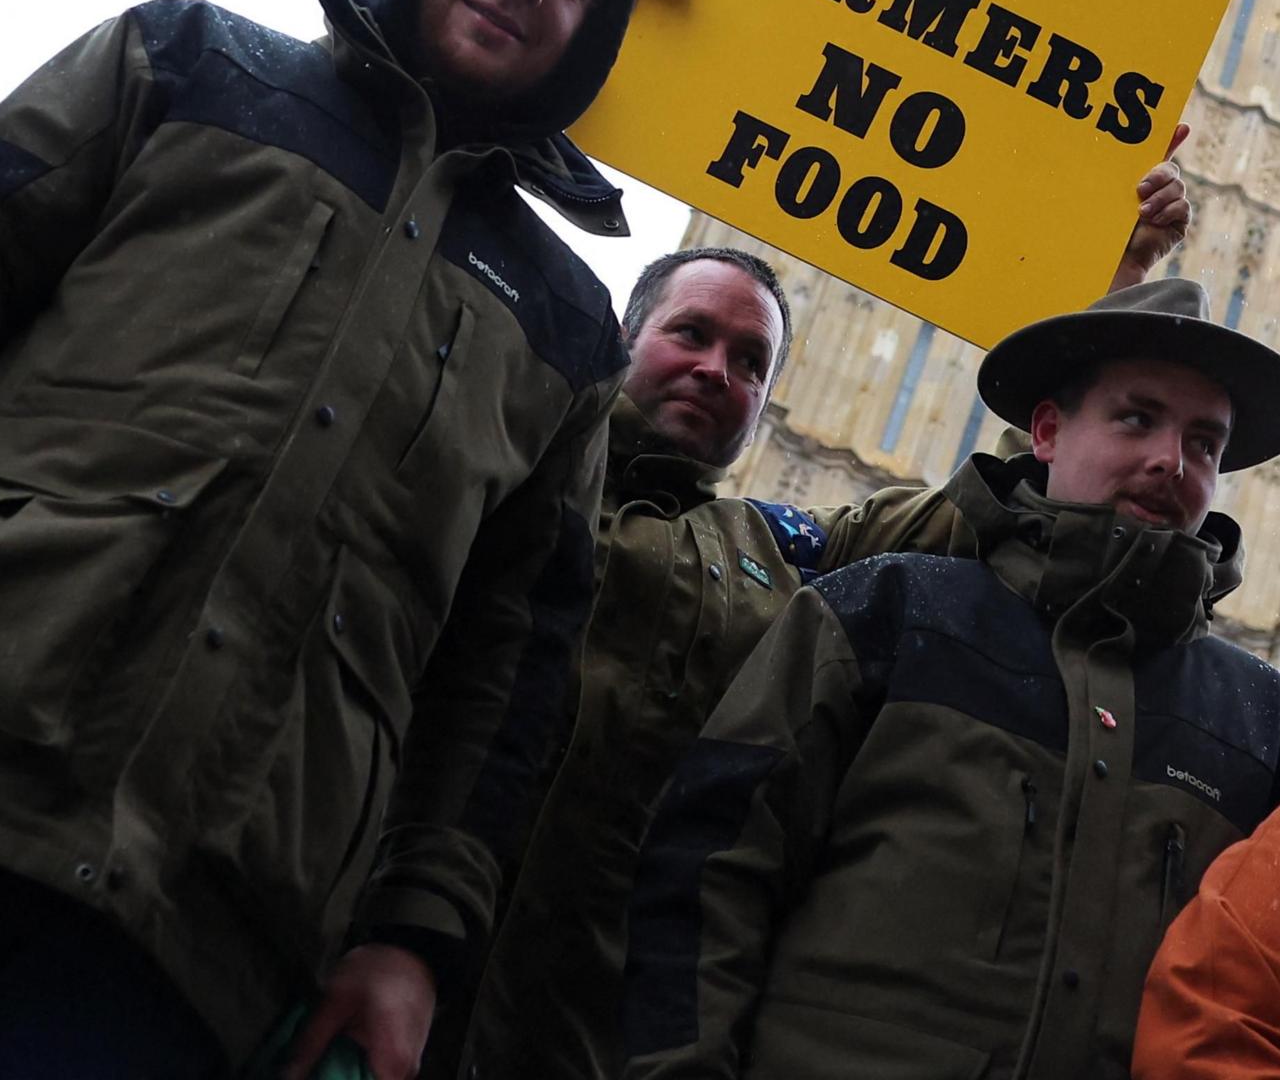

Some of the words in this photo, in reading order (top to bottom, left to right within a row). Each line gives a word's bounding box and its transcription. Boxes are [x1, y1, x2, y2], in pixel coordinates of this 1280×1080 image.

[795, 41, 966, 169] NO
[705, 109, 969, 281] FOOD
[468, 251, 520, 302] betacraft
[1166, 764, 1221, 802] betacraft
